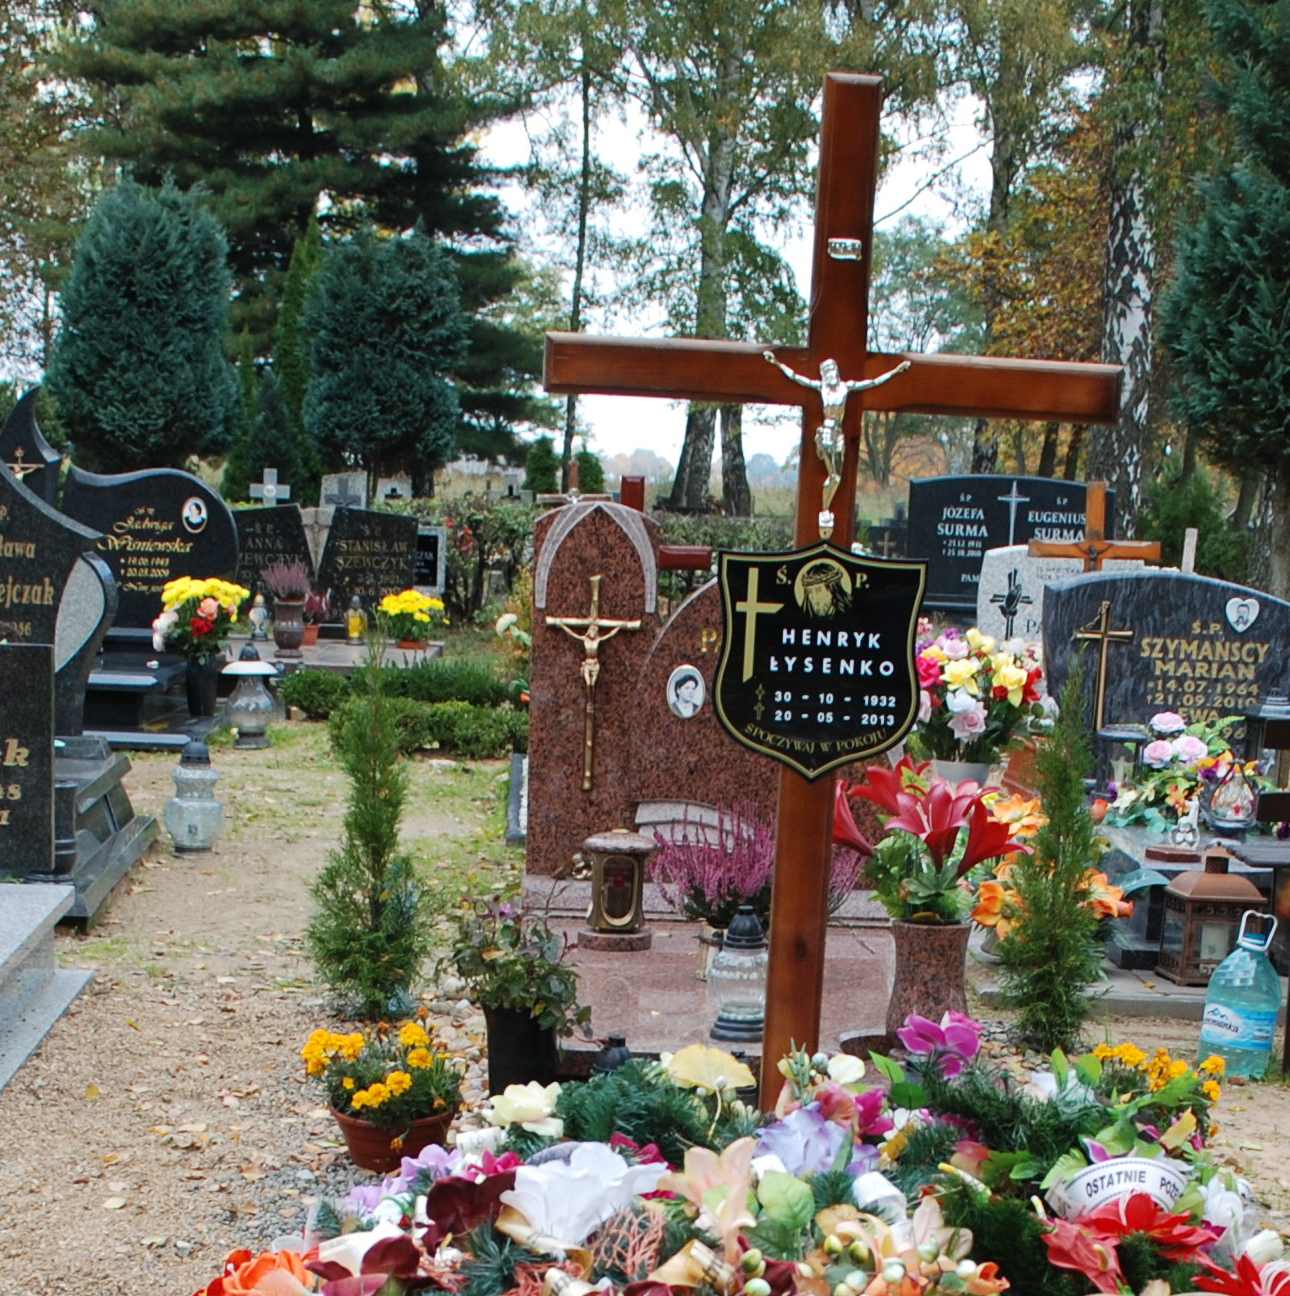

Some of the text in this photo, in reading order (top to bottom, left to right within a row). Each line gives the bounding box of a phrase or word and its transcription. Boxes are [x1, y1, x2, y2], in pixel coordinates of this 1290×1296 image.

[942, 505, 985, 521] JÓZEFA
[937, 523, 989, 537] SURMA
[1034, 527, 1085, 541] SURMA
[96, 534, 193, 553] Wiśniewska
[246, 537, 283, 549] ANNA
[340, 540, 408, 551] STANISŁAW
[336, 557, 409, 571] SZEWCZYK
[775, 565, 870, 589] Ś. P.
[782, 628, 881, 649] HENRYK
[1140, 635, 1270, 663] SZYMAŃSCY
[769, 655, 894, 676] ŁYSENKO
[1154, 659, 1256, 680] MARIAN
[774, 691, 792, 703] 30
[819, 693, 834, 704] 10
[863, 695, 896, 708] 1932
[774, 710, 792, 722] 20
[817, 712, 834, 724] 05
[861, 714, 895, 726] 2013
[744, 722, 887, 753] SPOCZYWAJ W POKOJU
[1085, 1170, 1147, 1198] OSTATNIE
